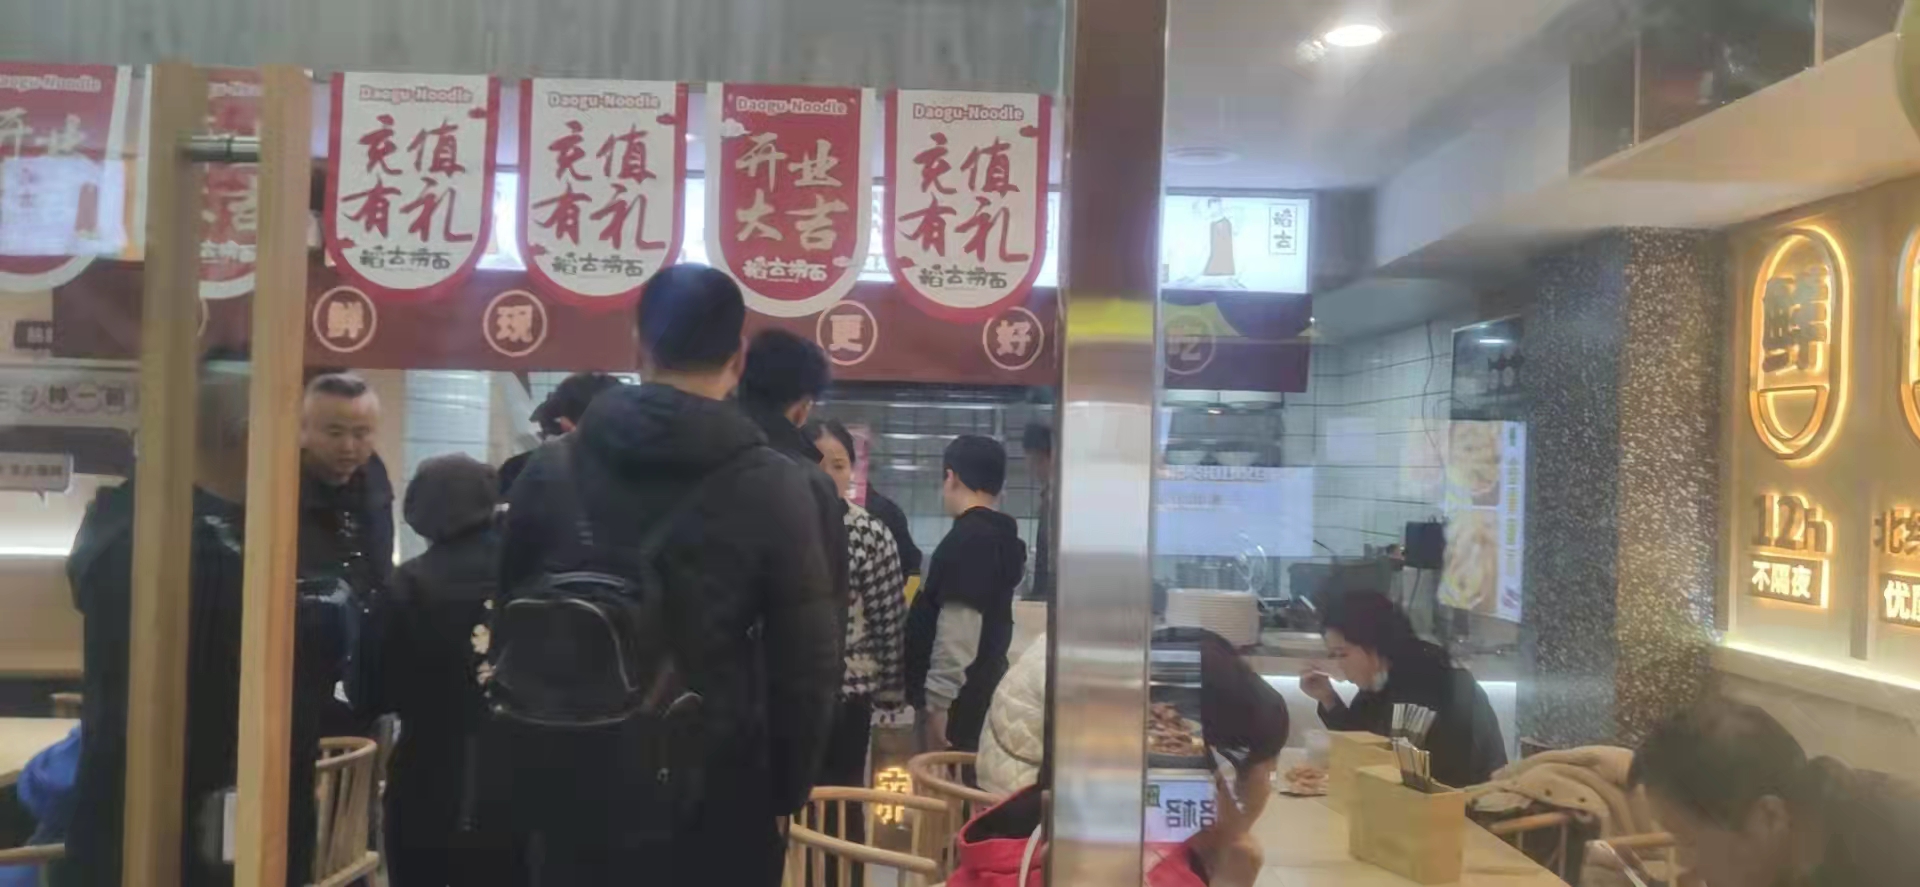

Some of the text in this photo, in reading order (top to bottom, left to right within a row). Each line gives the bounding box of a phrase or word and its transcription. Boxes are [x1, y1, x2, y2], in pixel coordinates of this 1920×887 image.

[359, 84, 473, 104] Daogu-Noodle
[548, 91, 661, 112] Daogu-Noodle
[735, 95, 849, 116] Daogu-Noodle
[912, 102, 1025, 123] Daogu-Noodle
[357, 114, 466, 178] 充值
[547, 119, 657, 185] 充值
[735, 131, 843, 192] 开业
[913, 131, 1021, 196] 充值
[341, 174, 473, 242] 有礼
[531, 182, 667, 250] 有礼
[735, 188, 850, 251] 大吉
[898, 193, 1030, 262] 有礼
[495, 304, 534, 342] 现
[828, 314, 864, 352] 更
[994, 319, 1032, 356] 好
[1762, 264, 1830, 374] 鲜
[1754, 494, 1832, 553] 12h
[1751, 560, 1813, 600] 不隔夜
